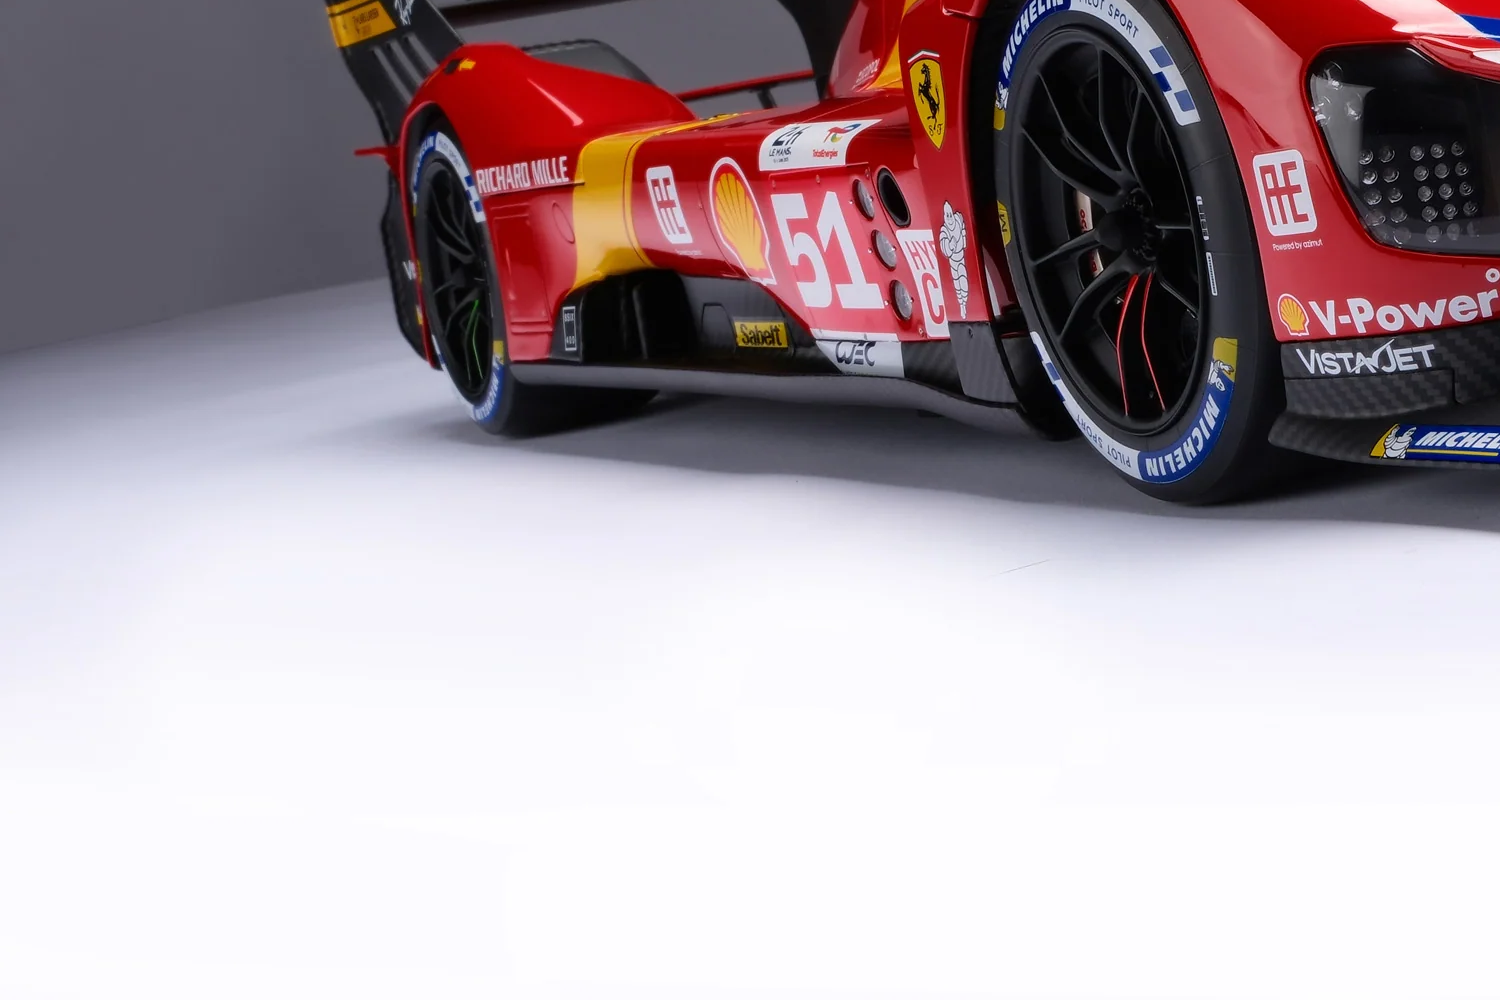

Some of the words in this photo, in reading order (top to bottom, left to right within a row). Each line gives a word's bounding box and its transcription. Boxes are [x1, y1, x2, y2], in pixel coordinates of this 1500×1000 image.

[1108, 3, 1139, 38] SPORT
[475, 162, 531, 193] RICHARD
[531, 156, 570, 185] MILLE
[770, 191, 885, 309] 51
[1272, 241, 1295, 251] Powered
[1308, 288, 1499, 336] V-Power
[741, 324, 781, 349] Sabelt
[1145, 393, 1220, 477] MICHELIN
